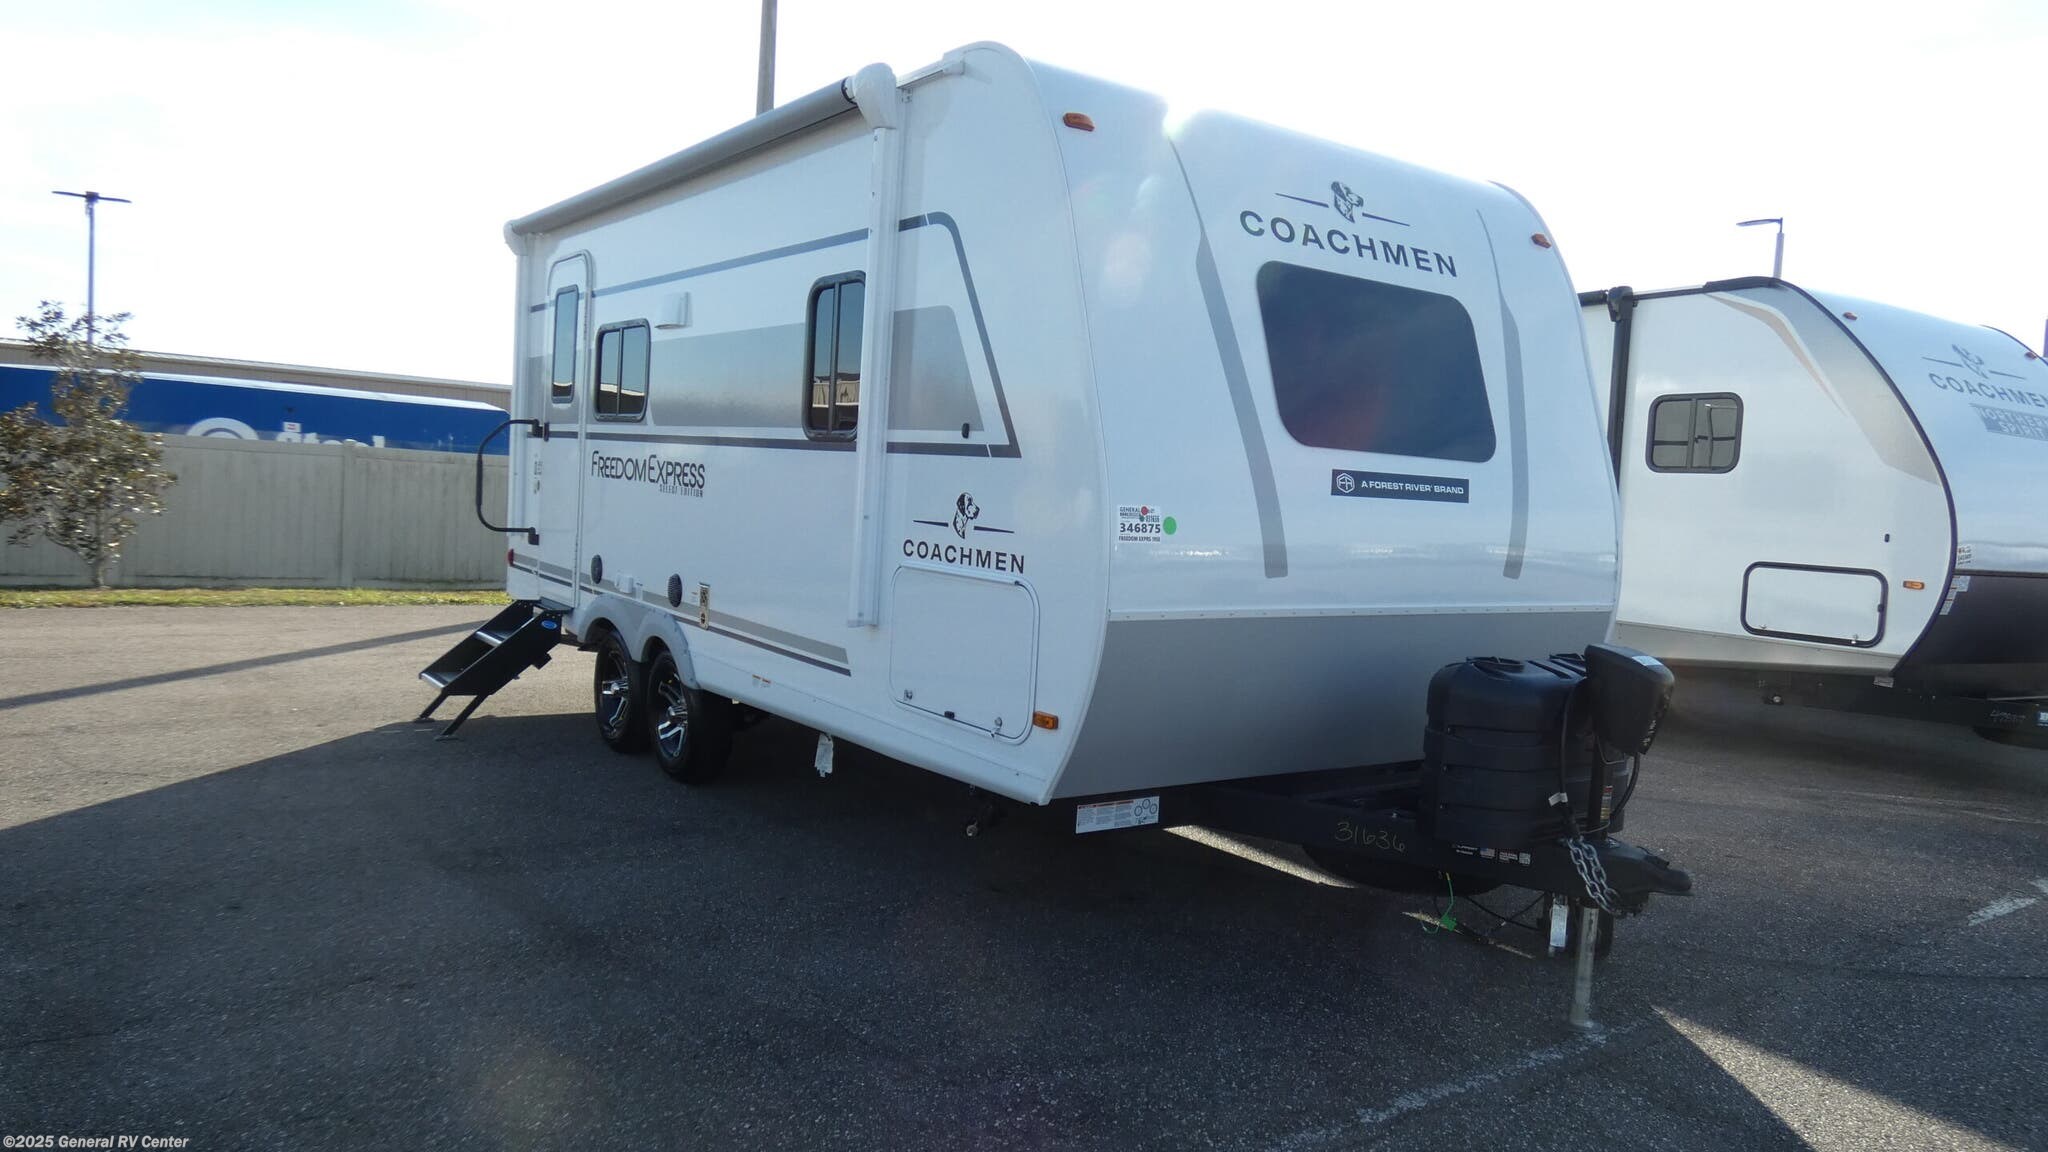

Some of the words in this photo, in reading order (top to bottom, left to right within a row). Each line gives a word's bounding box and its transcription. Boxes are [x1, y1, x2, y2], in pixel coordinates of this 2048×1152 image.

[1239, 210, 1458, 278] COACHMEN
[1361, 480, 1369, 489] A
[1369, 481, 1404, 491] FOREST
[1434, 485, 1464, 495] BRAND
[1119, 522, 1161, 534] 346875
[902, 539, 1025, 574] COACHMEN
[1335, 821, 1406, 853] 31636
